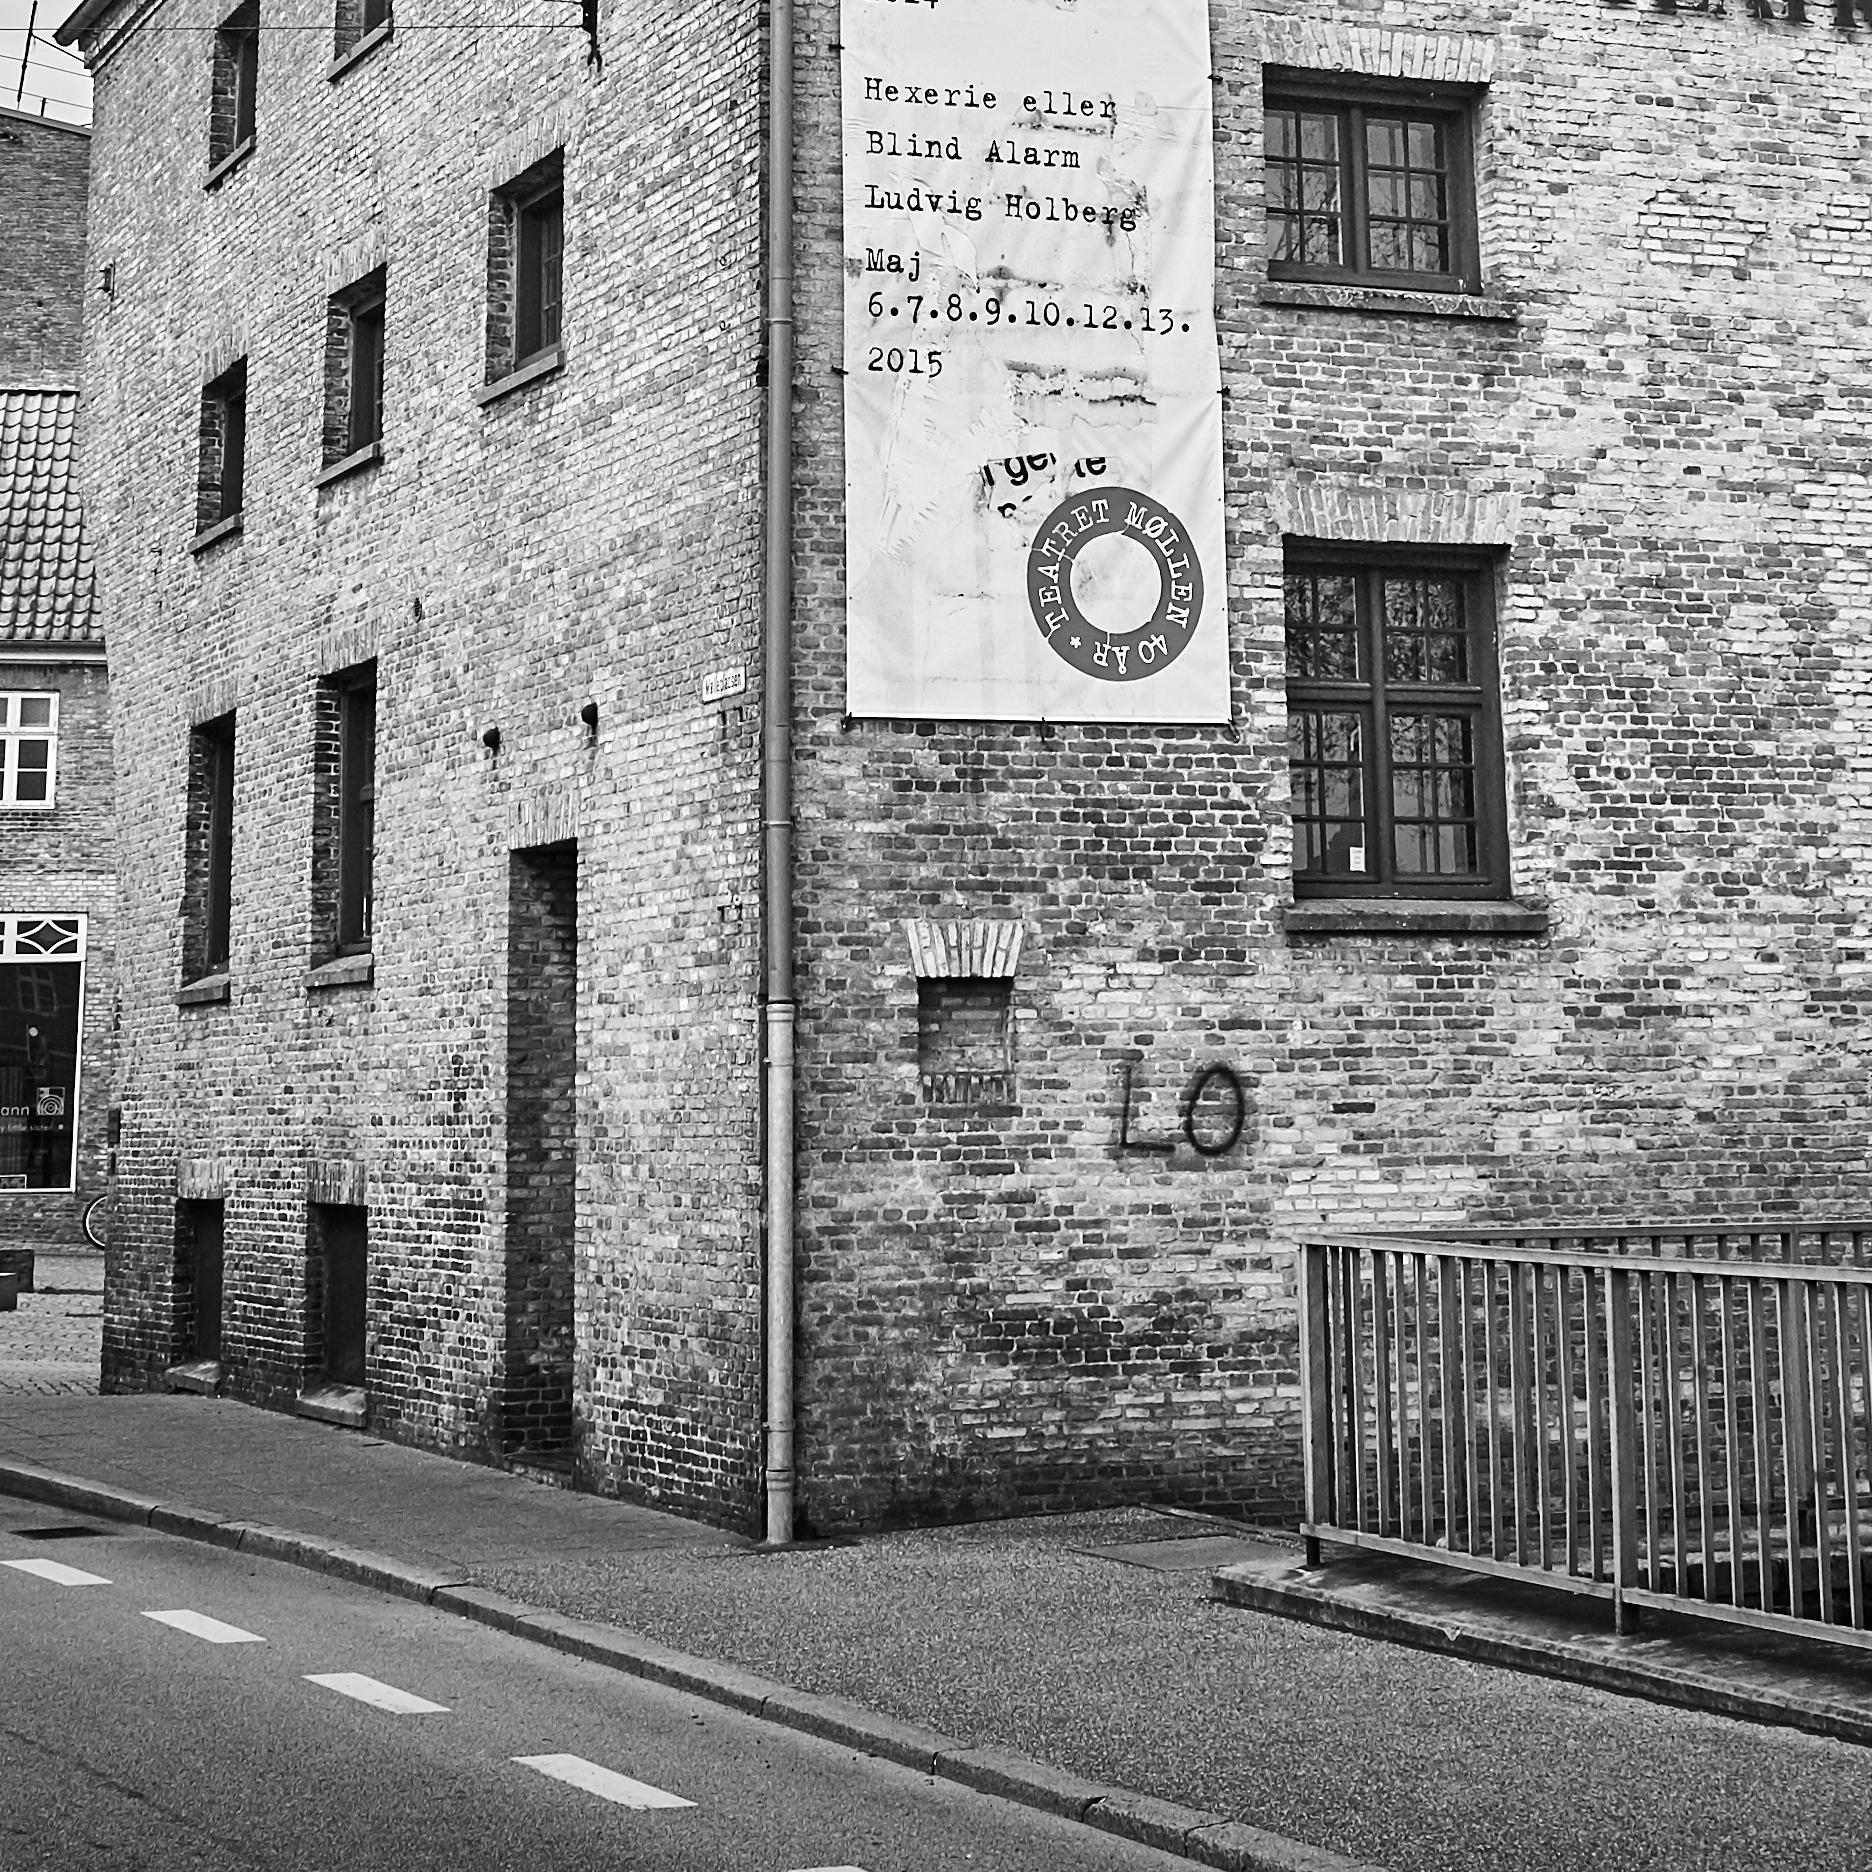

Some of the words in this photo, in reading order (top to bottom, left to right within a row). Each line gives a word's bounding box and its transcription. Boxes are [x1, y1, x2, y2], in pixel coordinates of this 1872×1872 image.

[864, 77, 996, 108] Hexerie
[1023, 91, 1116, 118] eller
[866, 131, 961, 159] Blind
[985, 140, 1080, 168] Alarm
[865, 185, 981, 220] Ludvig
[1006, 194, 1137, 231] Holberg
[866, 248, 919, 282] Maj
[869, 347, 942, 378] 2015
[1038, 499, 1109, 631] TEATRET
[1125, 502, 1192, 629] MØLLEN
[1093, 640, 1129, 674] ÅR
[1138, 634, 1168, 664] 40
